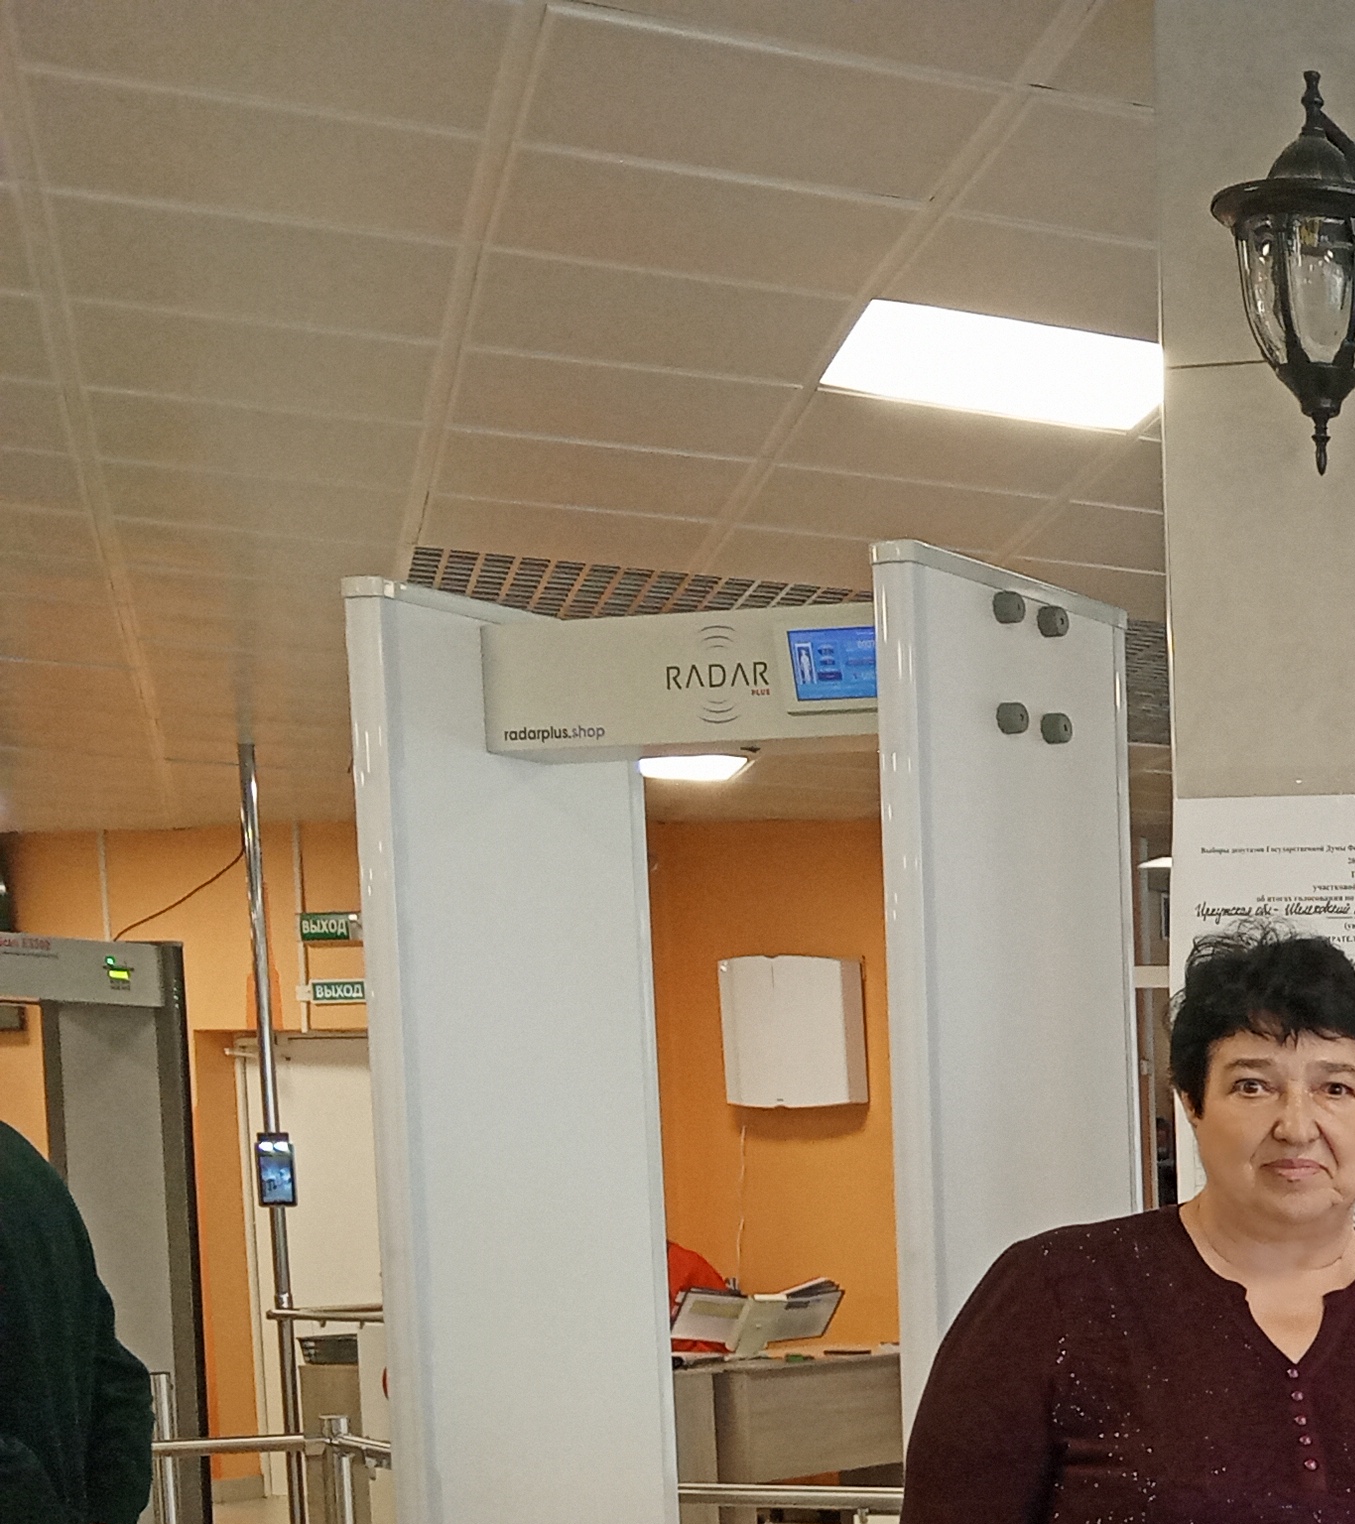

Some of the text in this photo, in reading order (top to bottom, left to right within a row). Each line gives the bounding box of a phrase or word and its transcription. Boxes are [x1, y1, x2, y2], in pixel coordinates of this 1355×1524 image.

[666, 661, 770, 690] RADAR
[751, 688, 771, 697] PLUS
[504, 725, 606, 744] radarplus.shop
[302, 918, 348, 936] ВЫХОД
[315, 984, 363, 998] ВЫХОД
